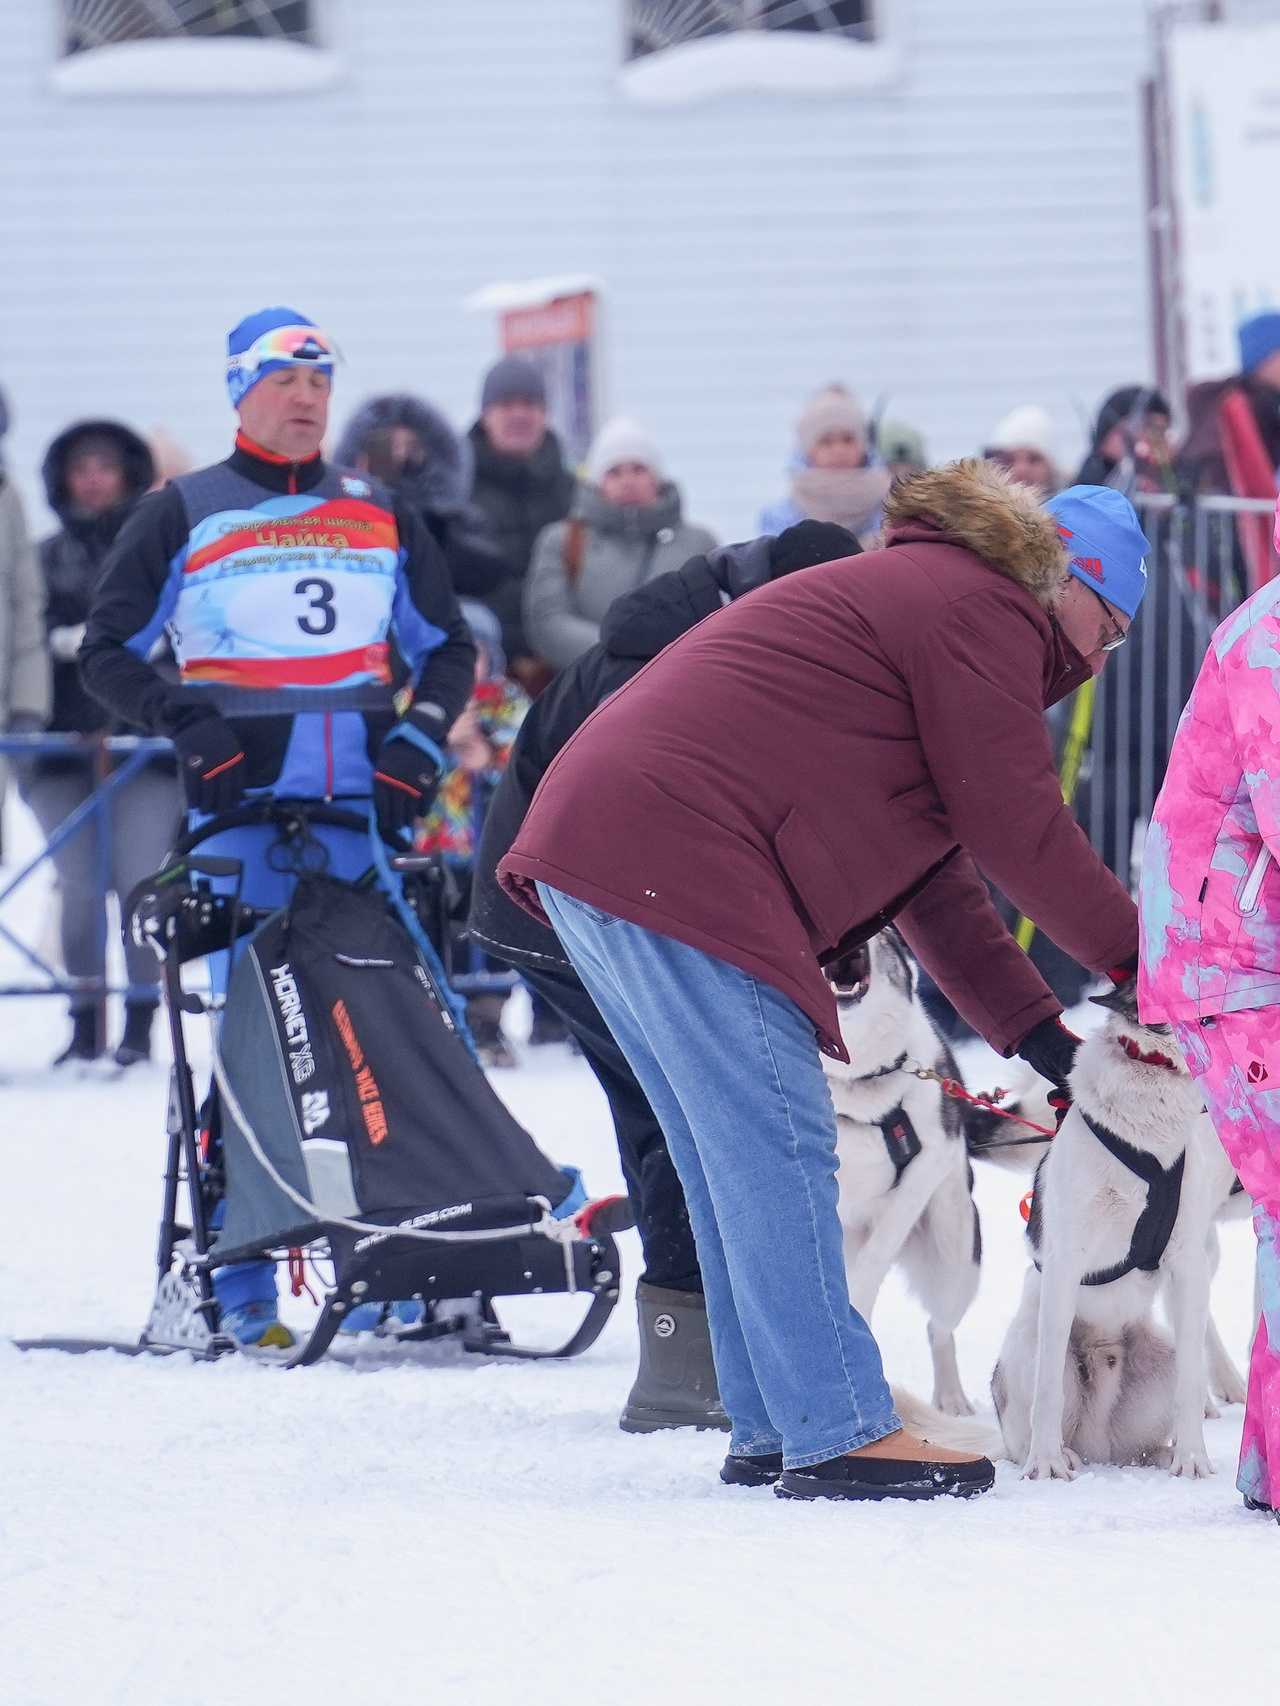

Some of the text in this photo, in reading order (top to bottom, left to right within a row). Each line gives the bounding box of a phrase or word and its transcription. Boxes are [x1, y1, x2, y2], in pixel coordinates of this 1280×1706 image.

[256, 528, 350, 549] Чайка
[294, 578, 337, 636] 3
[270, 963, 309, 1046] HORNET
